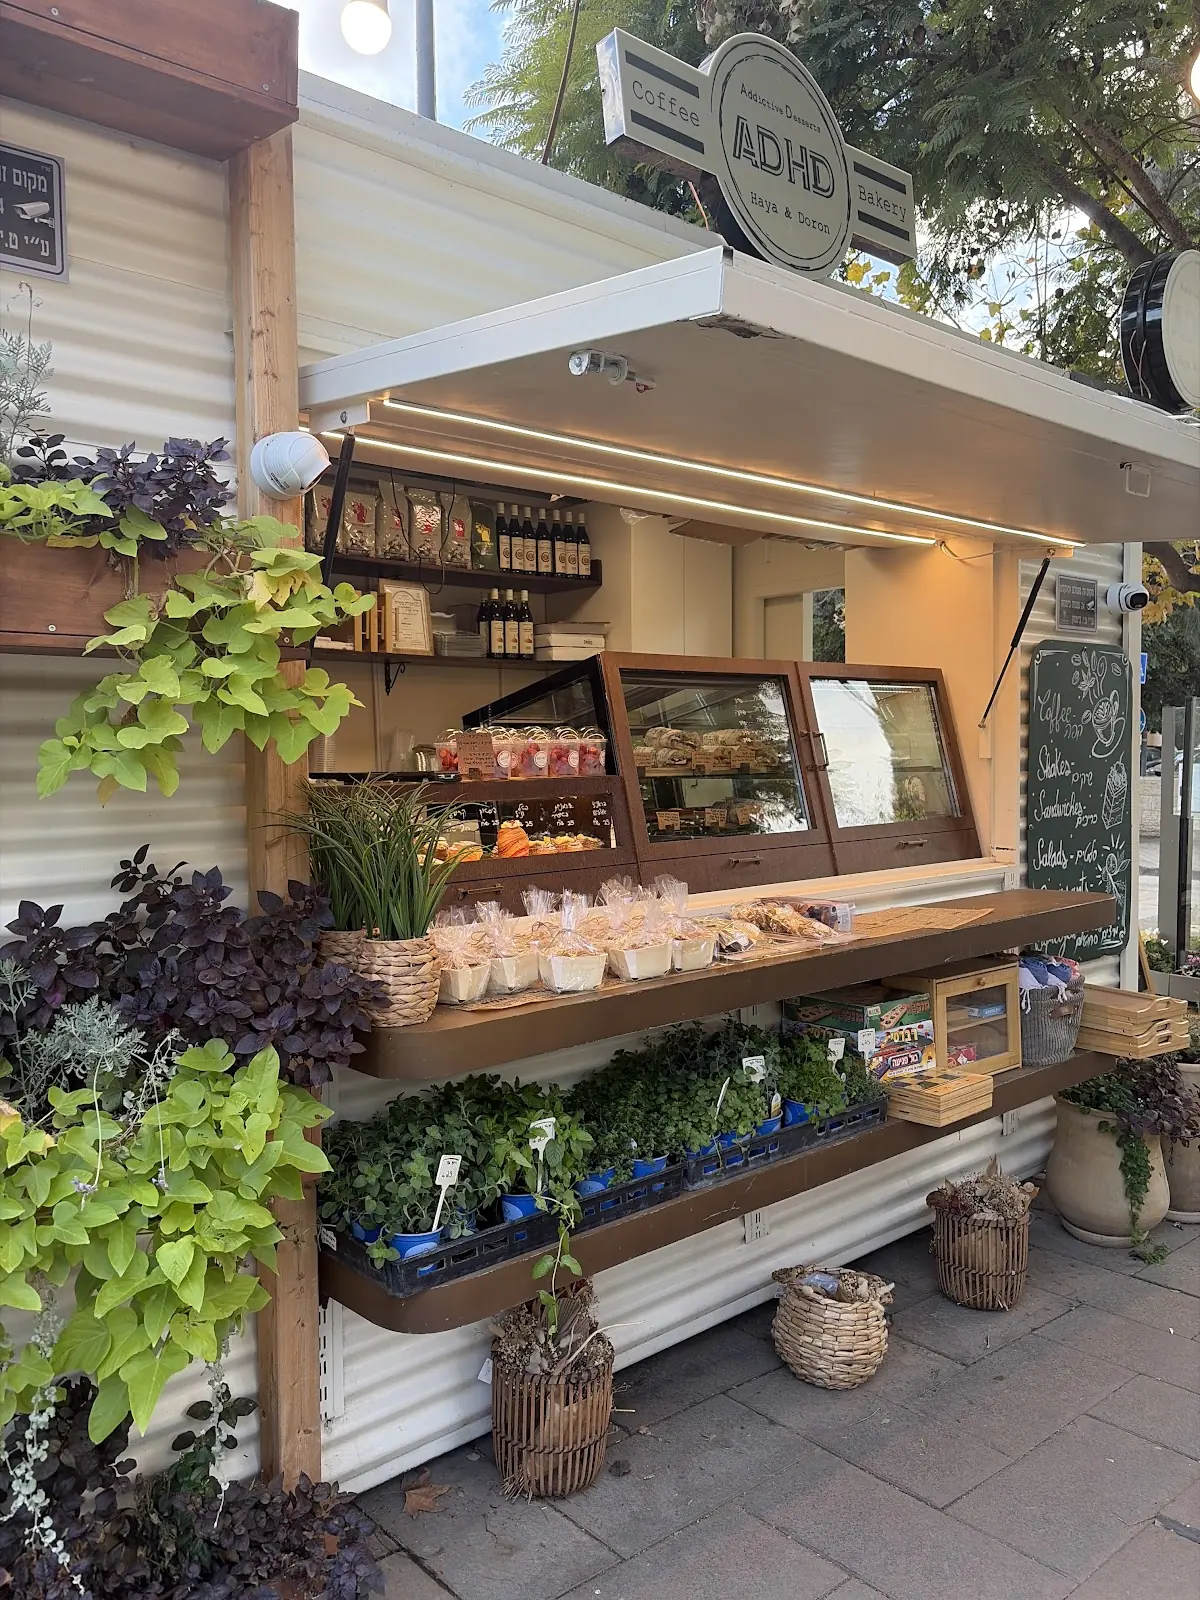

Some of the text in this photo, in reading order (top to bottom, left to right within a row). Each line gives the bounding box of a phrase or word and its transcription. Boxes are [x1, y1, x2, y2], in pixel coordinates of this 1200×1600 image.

[632, 79, 700, 128] Coffee
[740, 82, 821, 134] Addictive Desserts
[732, 115, 835, 198] ADHD
[13, 168, 47, 193] מקום
[858, 183, 908, 222] Bakery
[750, 191, 831, 235] Haya & Doron
[1063, 723, 1084, 741] קפה
